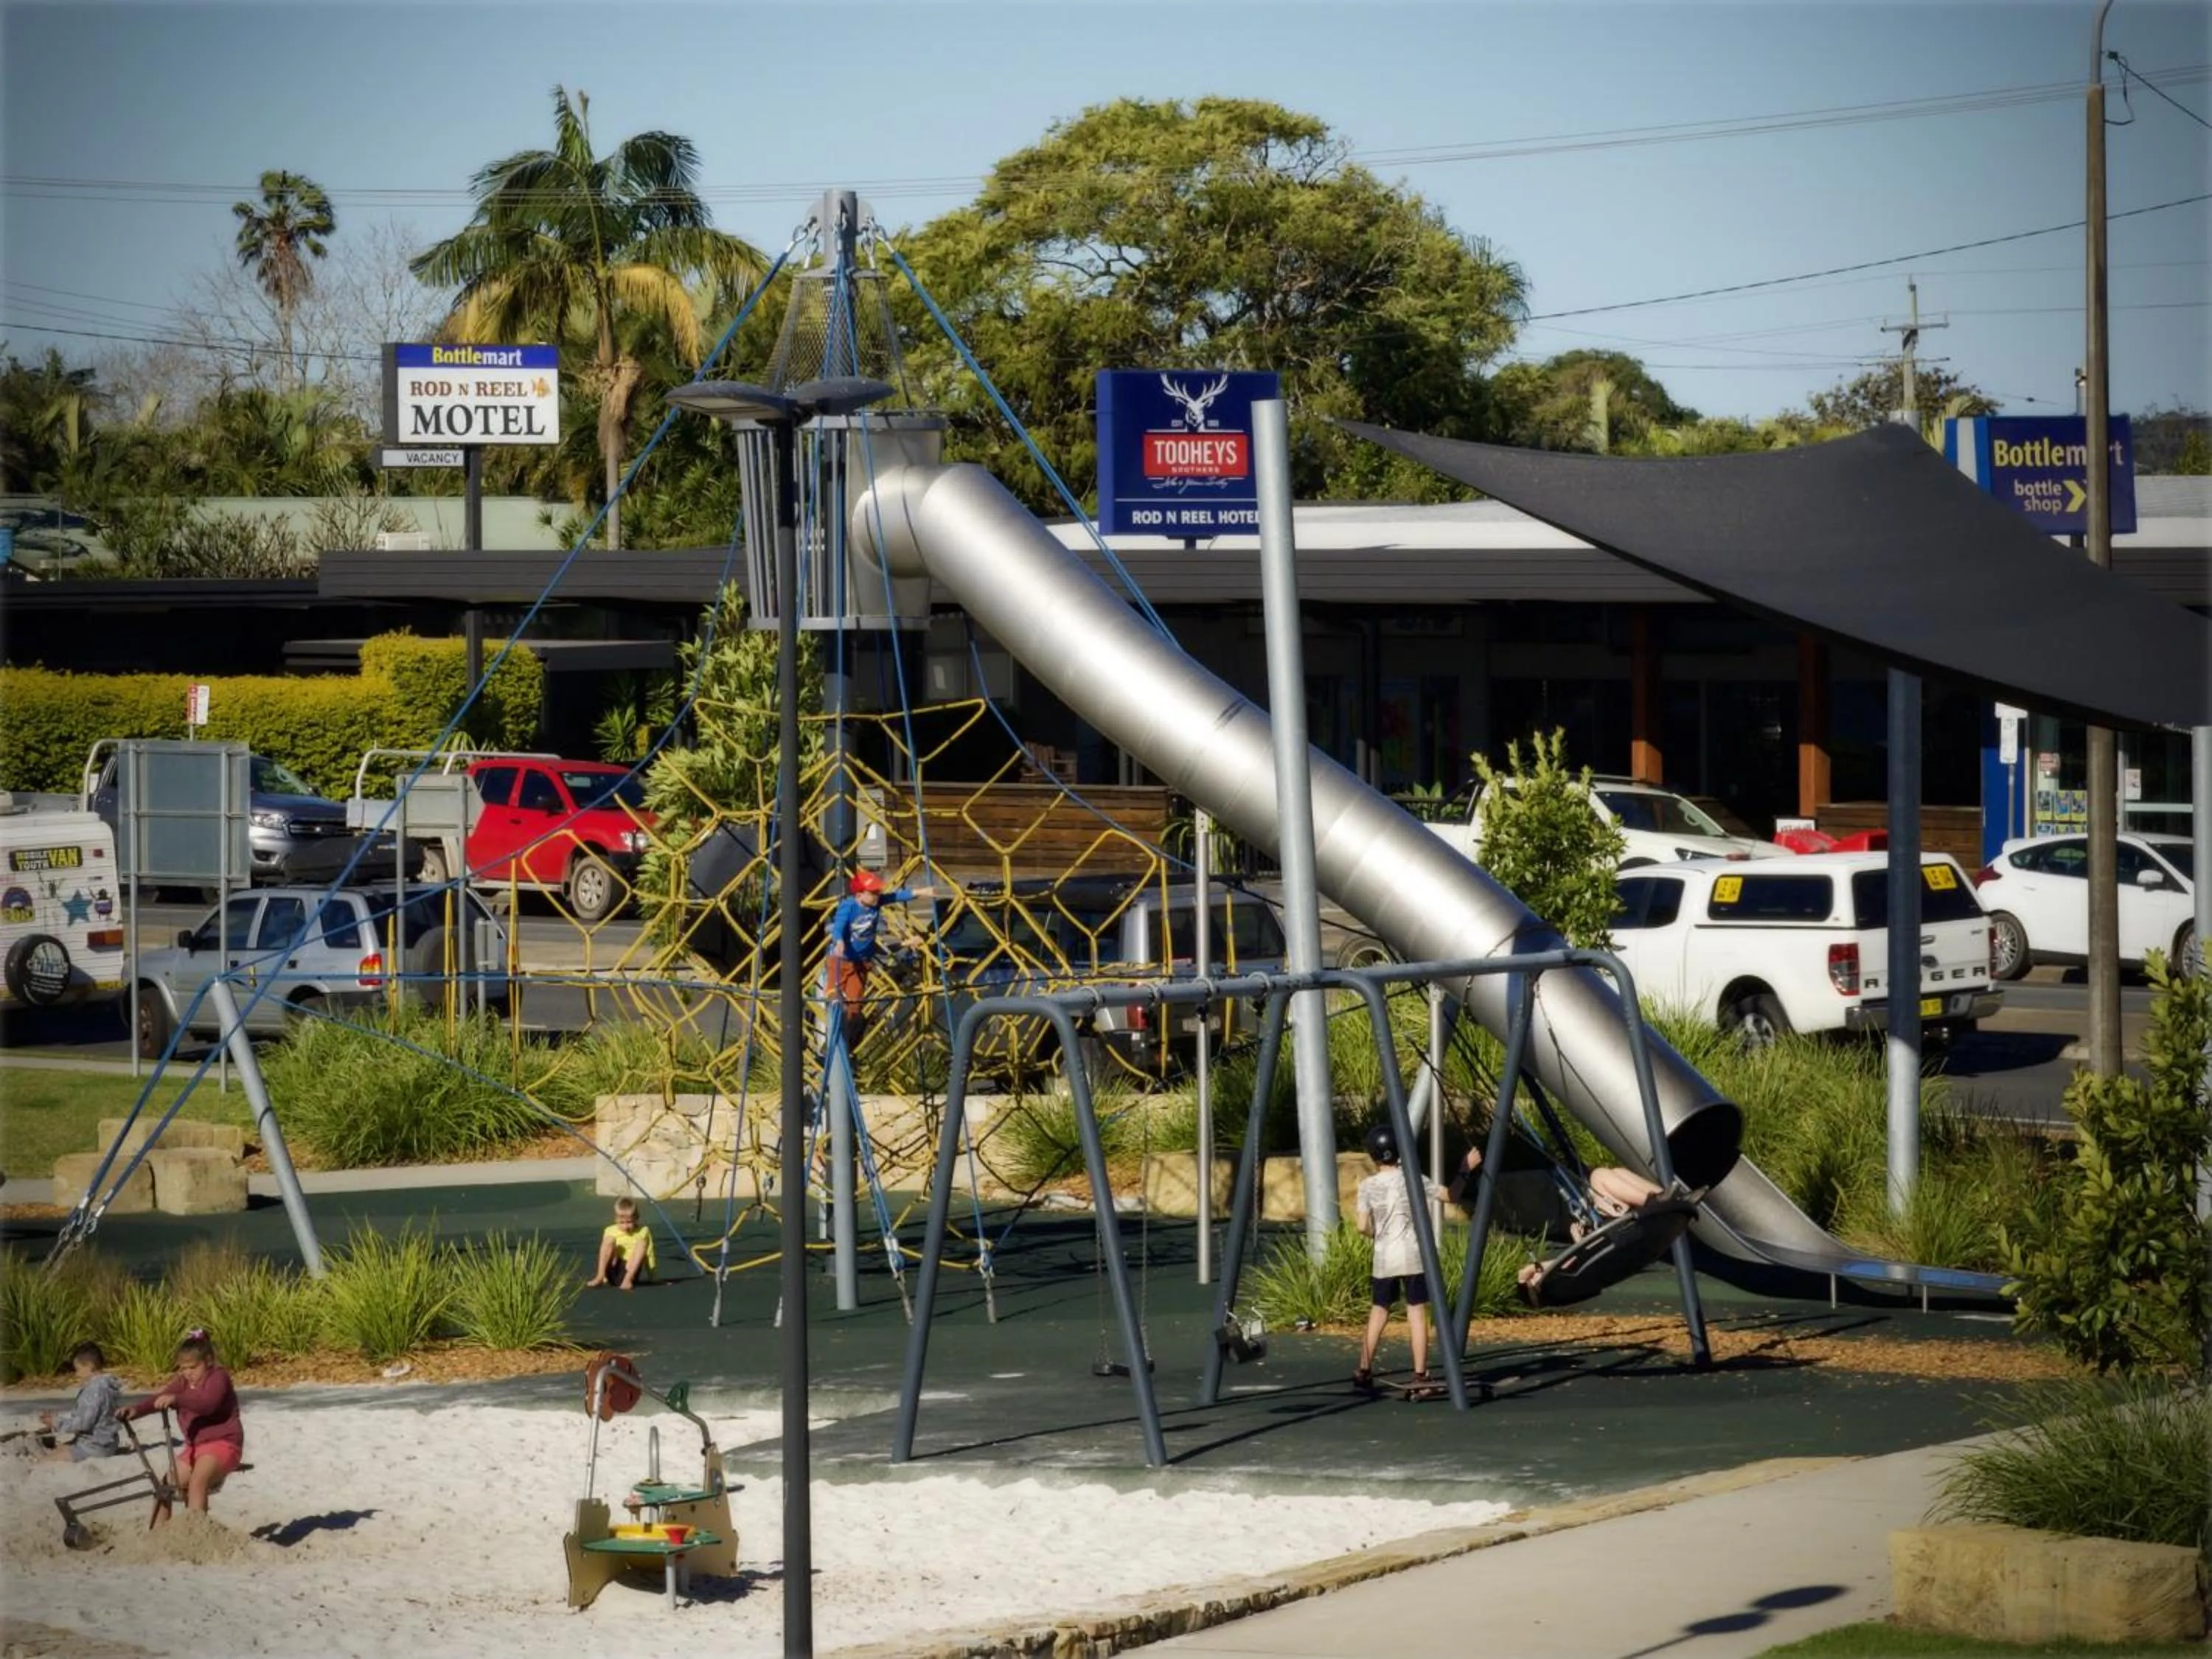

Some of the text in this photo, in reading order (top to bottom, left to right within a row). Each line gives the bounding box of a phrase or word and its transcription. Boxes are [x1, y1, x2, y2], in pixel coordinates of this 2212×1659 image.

[433, 347, 522, 366] Bottlemart
[411, 381, 527, 397] ROD N REEL
[411, 404, 546, 436] MOTEL
[406, 452, 459, 464] VACANCY
[1154, 440, 1237, 465] TOOHEYS
[1994, 437, 2124, 467] Bottlemt
[2014, 479, 2062, 496] bottle
[2024, 497, 2062, 515] shop
[1132, 509, 1162, 524] ROD
[1166, 510, 1177, 524] N
[1180, 510, 1214, 524] REEL
[17, 859, 49, 871] YOUTH
[49, 848, 79, 866] VAN
[1864, 966, 1986, 989] RGER
